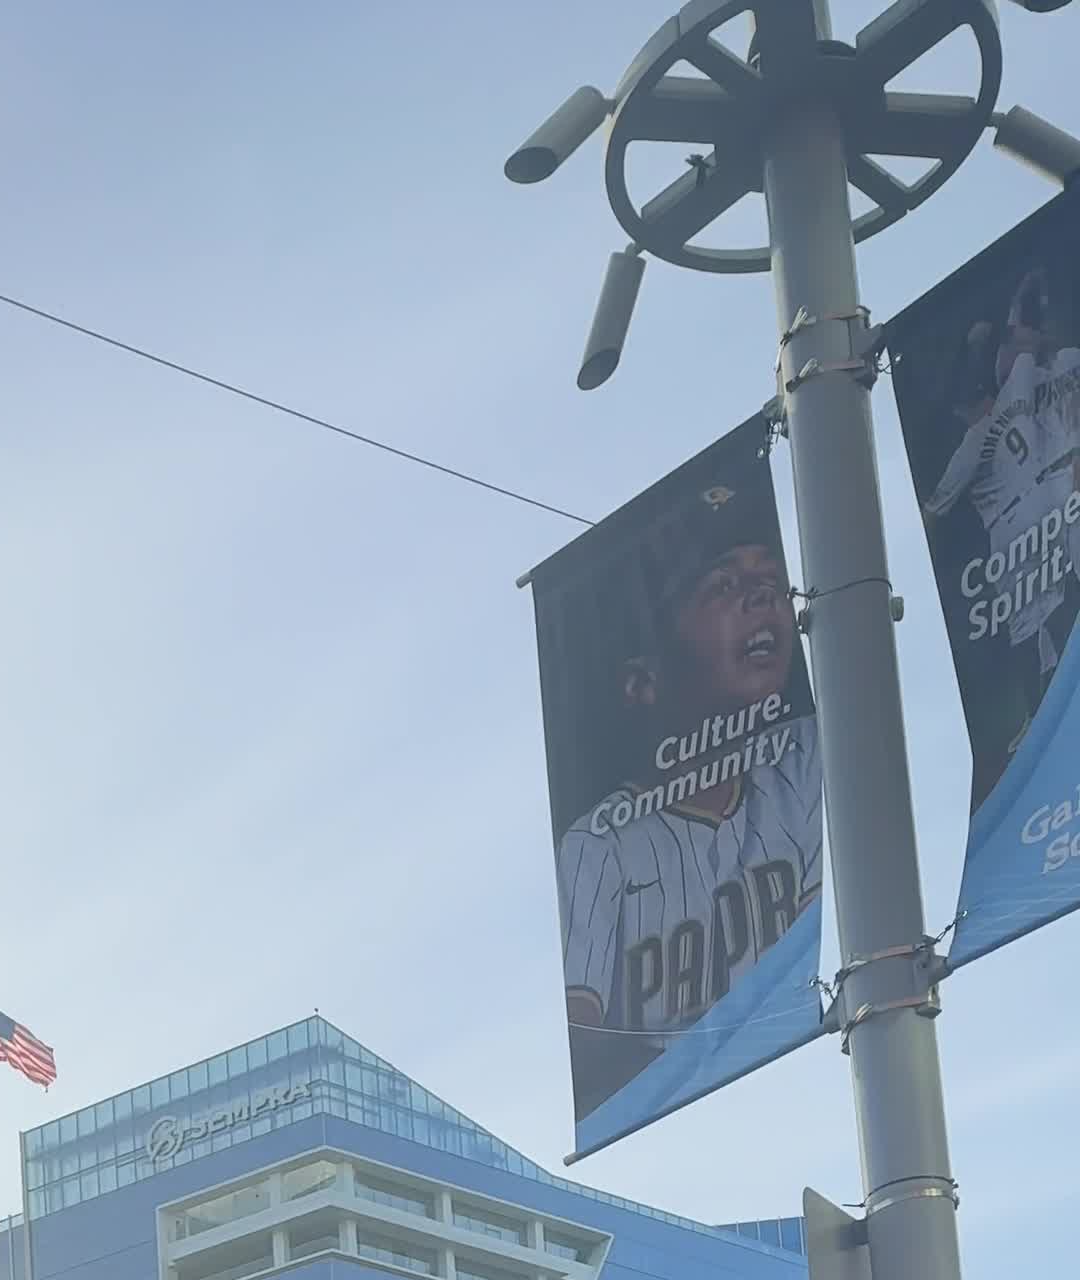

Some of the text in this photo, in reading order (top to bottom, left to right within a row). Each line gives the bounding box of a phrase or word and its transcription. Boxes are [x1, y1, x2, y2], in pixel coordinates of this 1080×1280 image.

[1005, 427, 1029, 467] 9
[960, 490, 1080, 598] Compe
[968, 545, 1073, 641] Spirit.
[655, 692, 791, 770] Culture.
[590, 727, 796, 836] Community.
